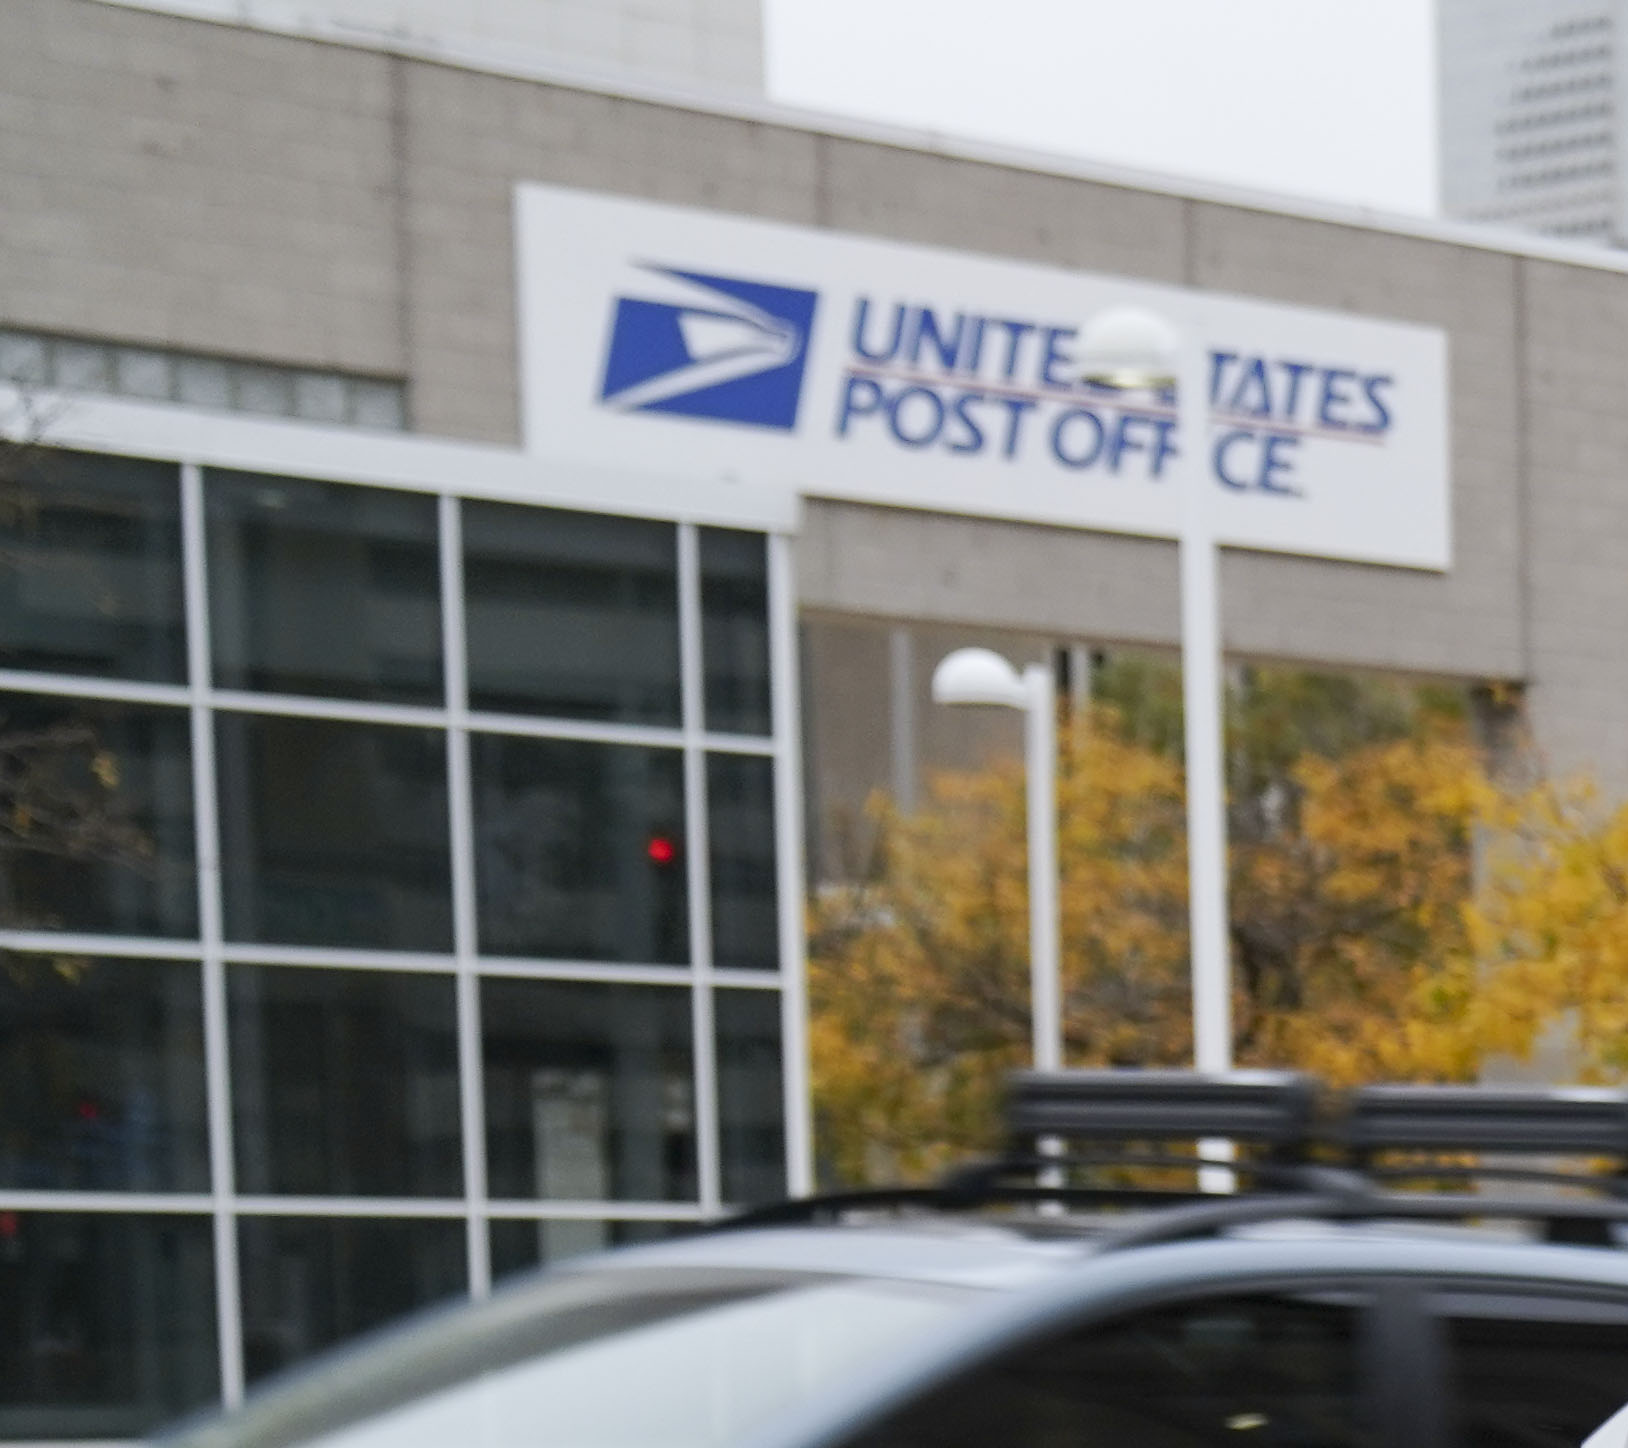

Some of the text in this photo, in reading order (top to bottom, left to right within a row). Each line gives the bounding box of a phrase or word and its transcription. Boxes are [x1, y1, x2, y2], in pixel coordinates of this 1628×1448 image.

[851, 296, 1395, 438] UNITE TATES
[836, 375, 1308, 500] POST OFFCE
